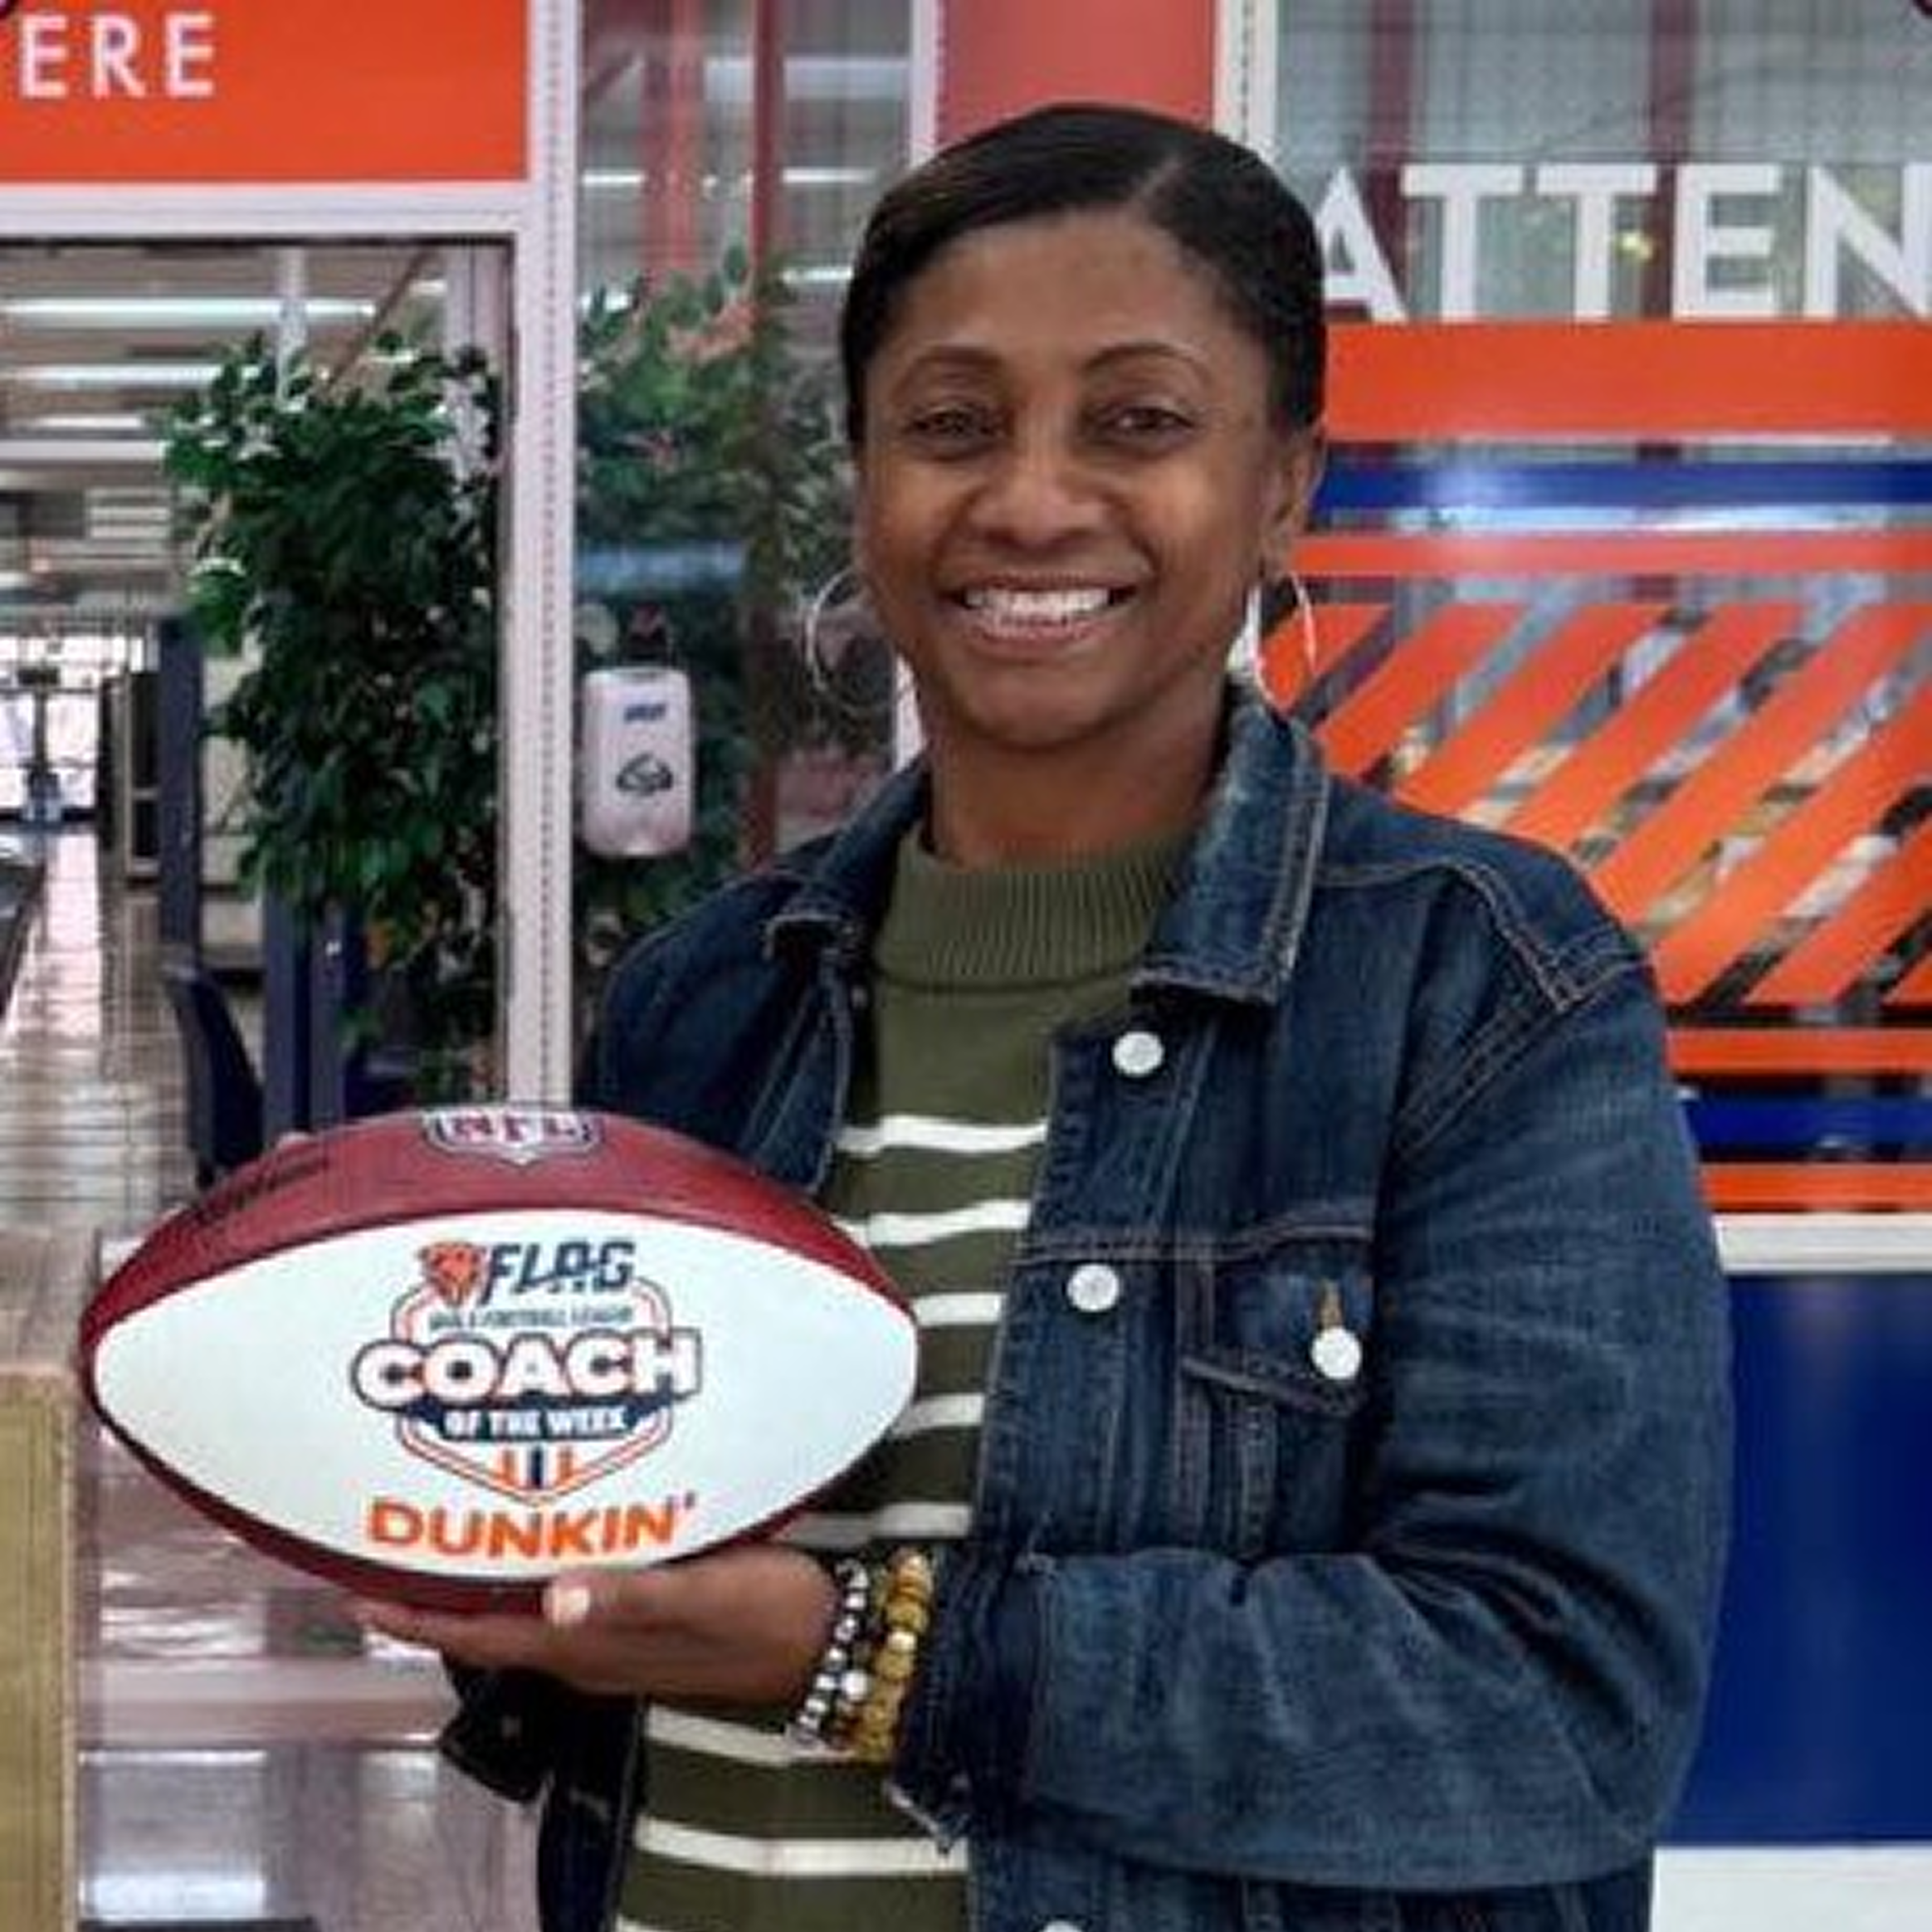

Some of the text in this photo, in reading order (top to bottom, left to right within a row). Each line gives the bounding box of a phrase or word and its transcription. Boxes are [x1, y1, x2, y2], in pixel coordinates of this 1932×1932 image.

[20, 13, 215, 99] ERE
[1315, 163, 1932, 323] ATTEN
[481, 1240, 637, 1305] FLAG
[351, 1326, 702, 1412] COACH
[444, 1407, 627, 1437] OF THE WEEK
[369, 1491, 697, 1559] DUNKIN'
